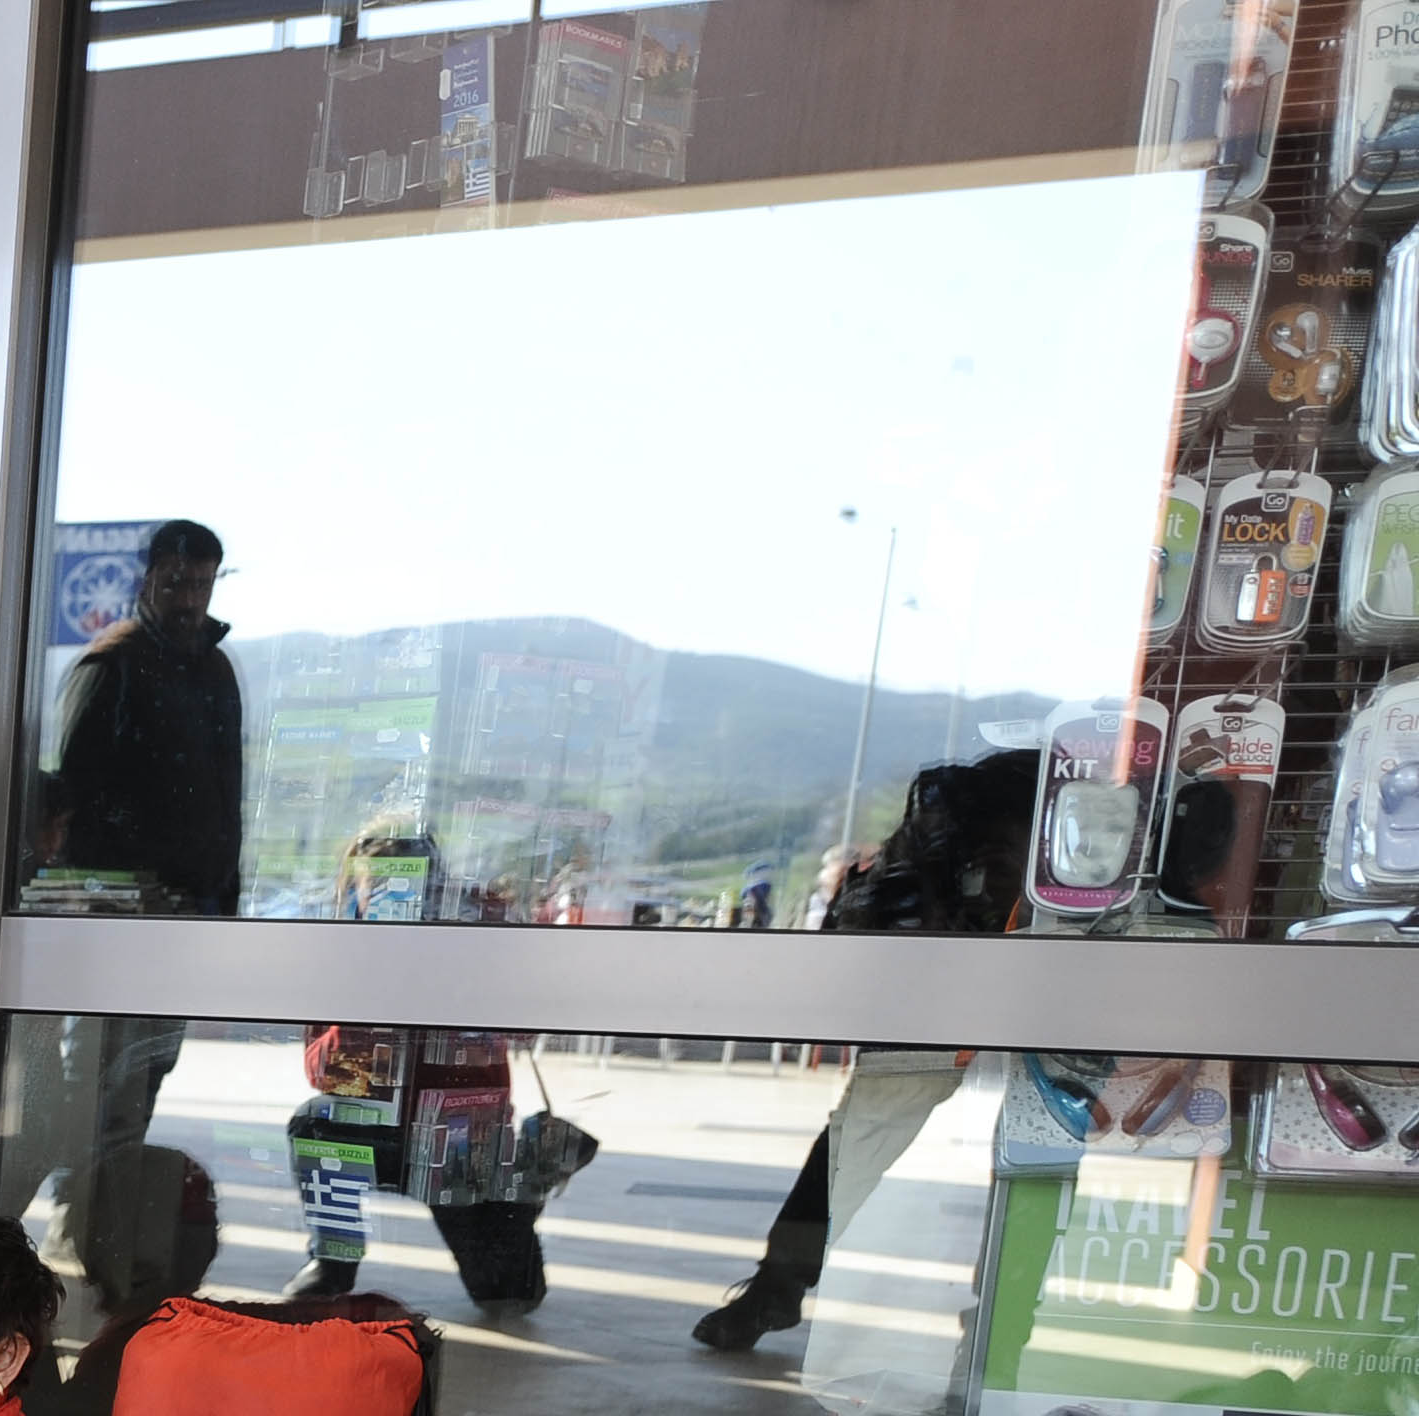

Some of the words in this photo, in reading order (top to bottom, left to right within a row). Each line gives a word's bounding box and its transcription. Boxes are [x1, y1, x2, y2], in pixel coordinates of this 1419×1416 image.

[453, 90, 479, 107] 2016
[1297, 273, 1373, 287] SHARER
[1266, 494, 1285, 506] Go
[1222, 522, 1287, 541] LOCK
[1223, 718, 1241, 730] Go
[1053, 758, 1099, 779] KIT
[1036, 1234, 1419, 1324] ACCESSORIE
[1315, 1344, 1348, 1369] the
[1355, 1347, 1419, 1376] journe
